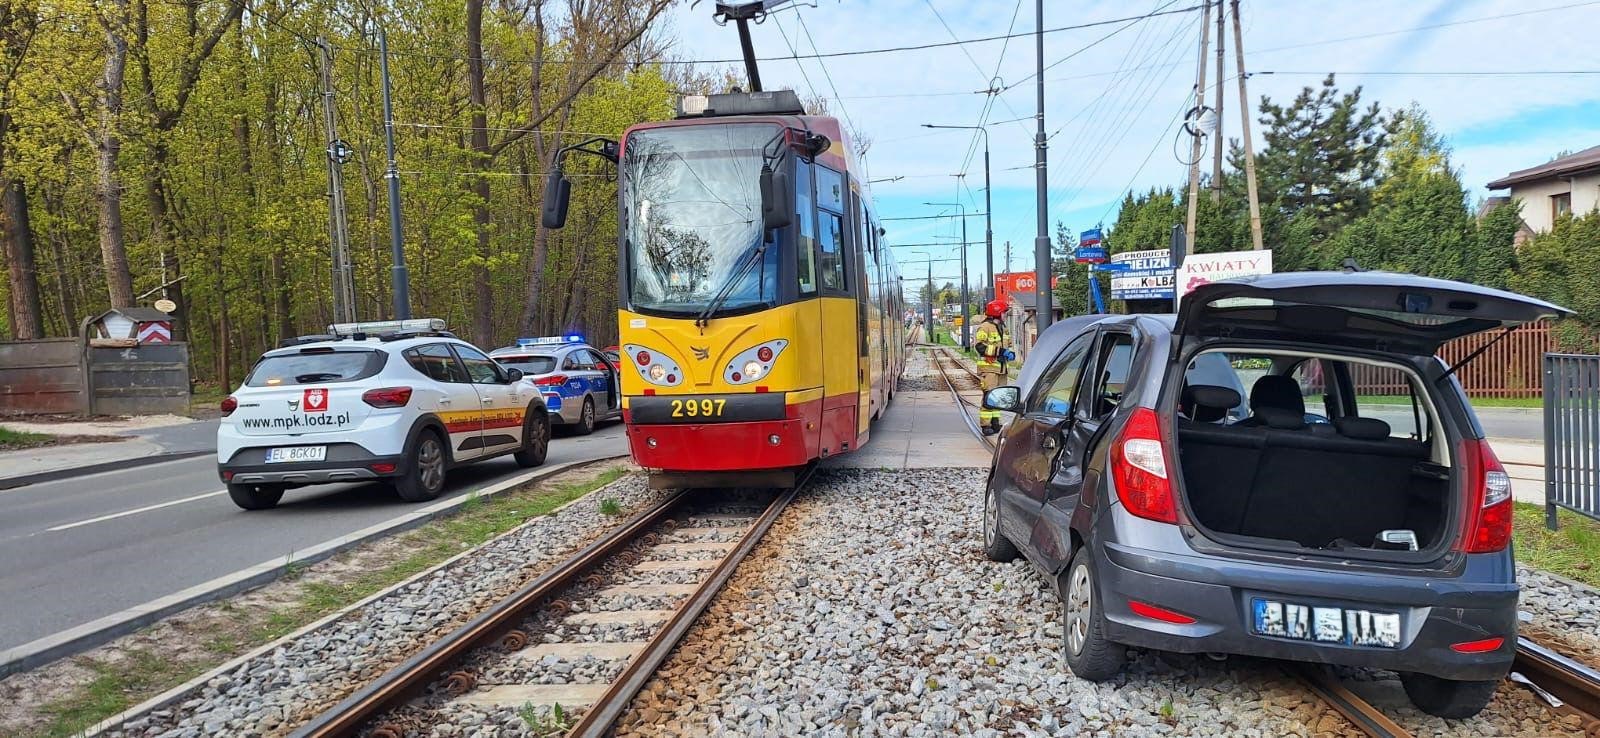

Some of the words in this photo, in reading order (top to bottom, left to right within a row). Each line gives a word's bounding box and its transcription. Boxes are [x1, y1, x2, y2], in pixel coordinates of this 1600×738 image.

[1187, 257, 1261, 273] KWIATY
[671, 399, 726, 417] 2997
[243, 412, 350, 430] www.mpk.lodz.pl
[273, 449, 285, 460] EL
[290, 447, 322, 459] 8GK01
